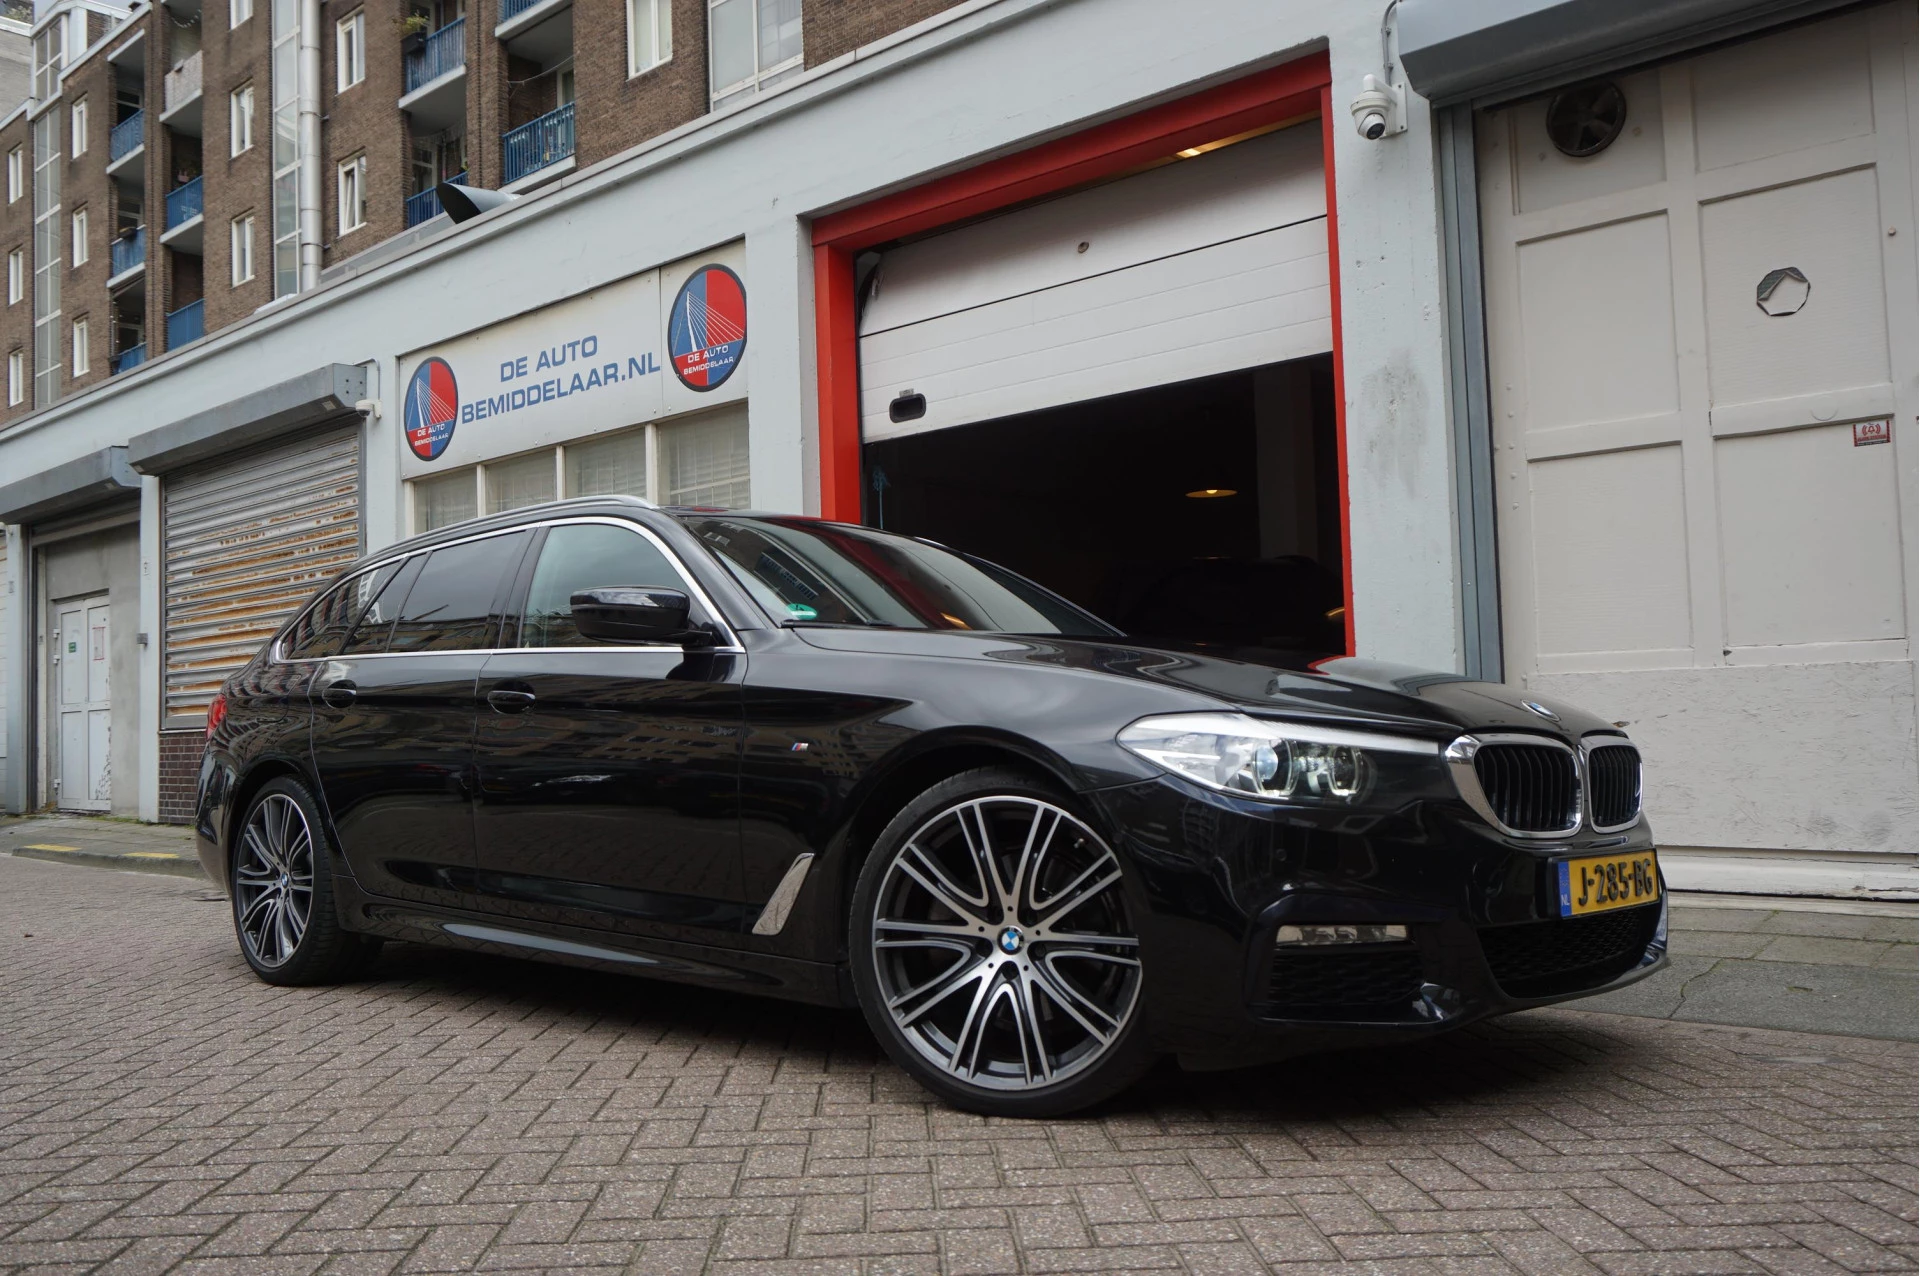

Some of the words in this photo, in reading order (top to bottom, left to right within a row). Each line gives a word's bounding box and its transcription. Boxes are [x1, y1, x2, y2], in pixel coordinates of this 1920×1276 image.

[500, 355, 528, 382] DE
[535, 335, 598, 372] AUTO
[687, 352, 700, 363] DE
[702, 345, 729, 359] AUTO
[683, 356, 734, 375] BEMIDDELAAR
[461, 352, 661, 424] BEMIDDELAAR.NL
[417, 428, 426, 437] DE
[427, 423, 445, 434] AUTO
[1578, 858, 1654, 907] J-285-BG
[1560, 894, 1570, 906] NL
